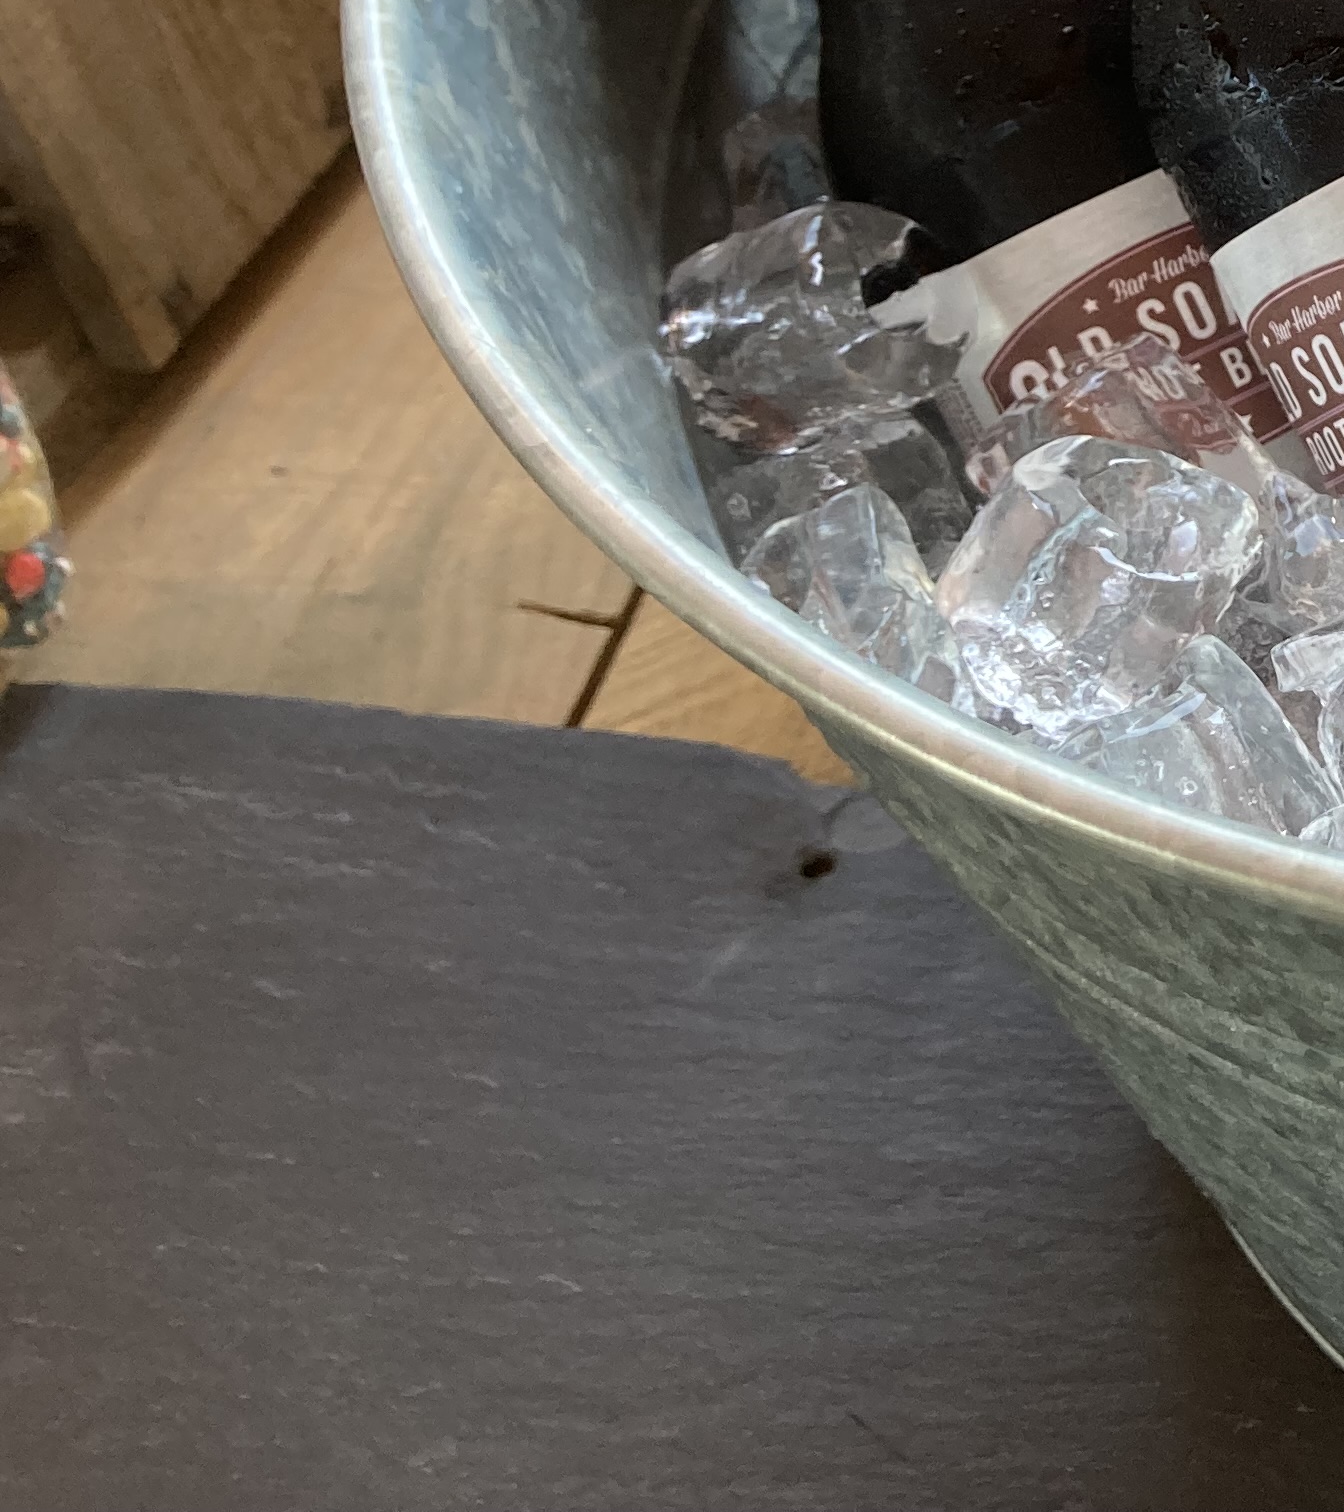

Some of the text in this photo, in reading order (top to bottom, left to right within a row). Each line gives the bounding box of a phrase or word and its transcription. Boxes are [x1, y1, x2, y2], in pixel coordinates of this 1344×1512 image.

[1107, 269, 1148, 304] Bar
[1268, 317, 1294, 346] Bar
[1290, 289, 1344, 335] Harbor
